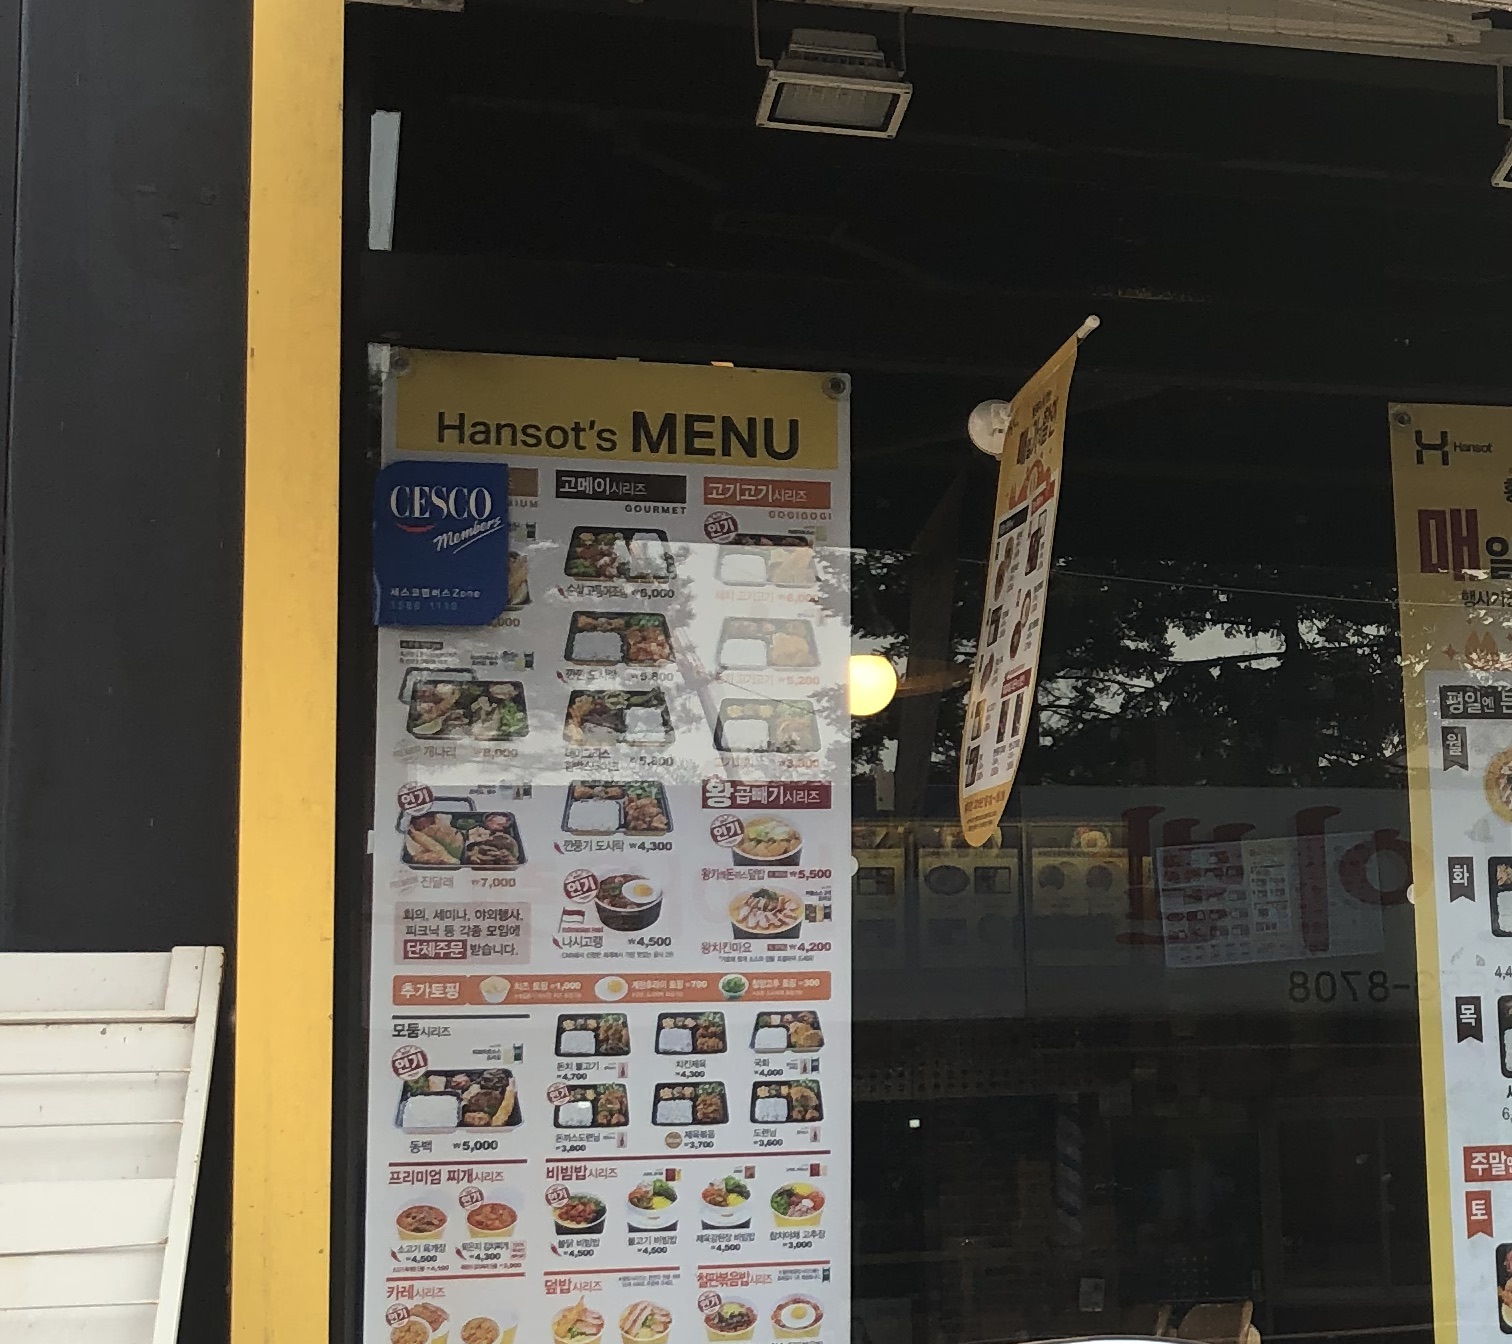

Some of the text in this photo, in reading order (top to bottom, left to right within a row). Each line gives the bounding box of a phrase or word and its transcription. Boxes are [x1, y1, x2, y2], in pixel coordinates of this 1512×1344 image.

[438, 411, 800, 461] Hansot's MENU
[1454, 442, 1493, 453] Hansot
[560, 476, 647, 498] 고메이시리즈
[707, 483, 806, 503] 고기고기시리즈
[390, 486, 492, 520] CESCO
[625, 504, 687, 515] GOURMET
[433, 516, 502, 551] Members
[1447, 692, 1495, 714] 평일엔
[1452, 865, 1469, 886] 화
[407, 942, 464, 958] 단체주문
[401, 982, 460, 999] 추가토핑
[1460, 1004, 1477, 1026] 목
[410, 1140, 433, 1153] 동백
[388, 1169, 442, 1185] 프리미엄
[1471, 1200, 1488, 1220] 토
[387, 1284, 446, 1300] 카레시리즈
